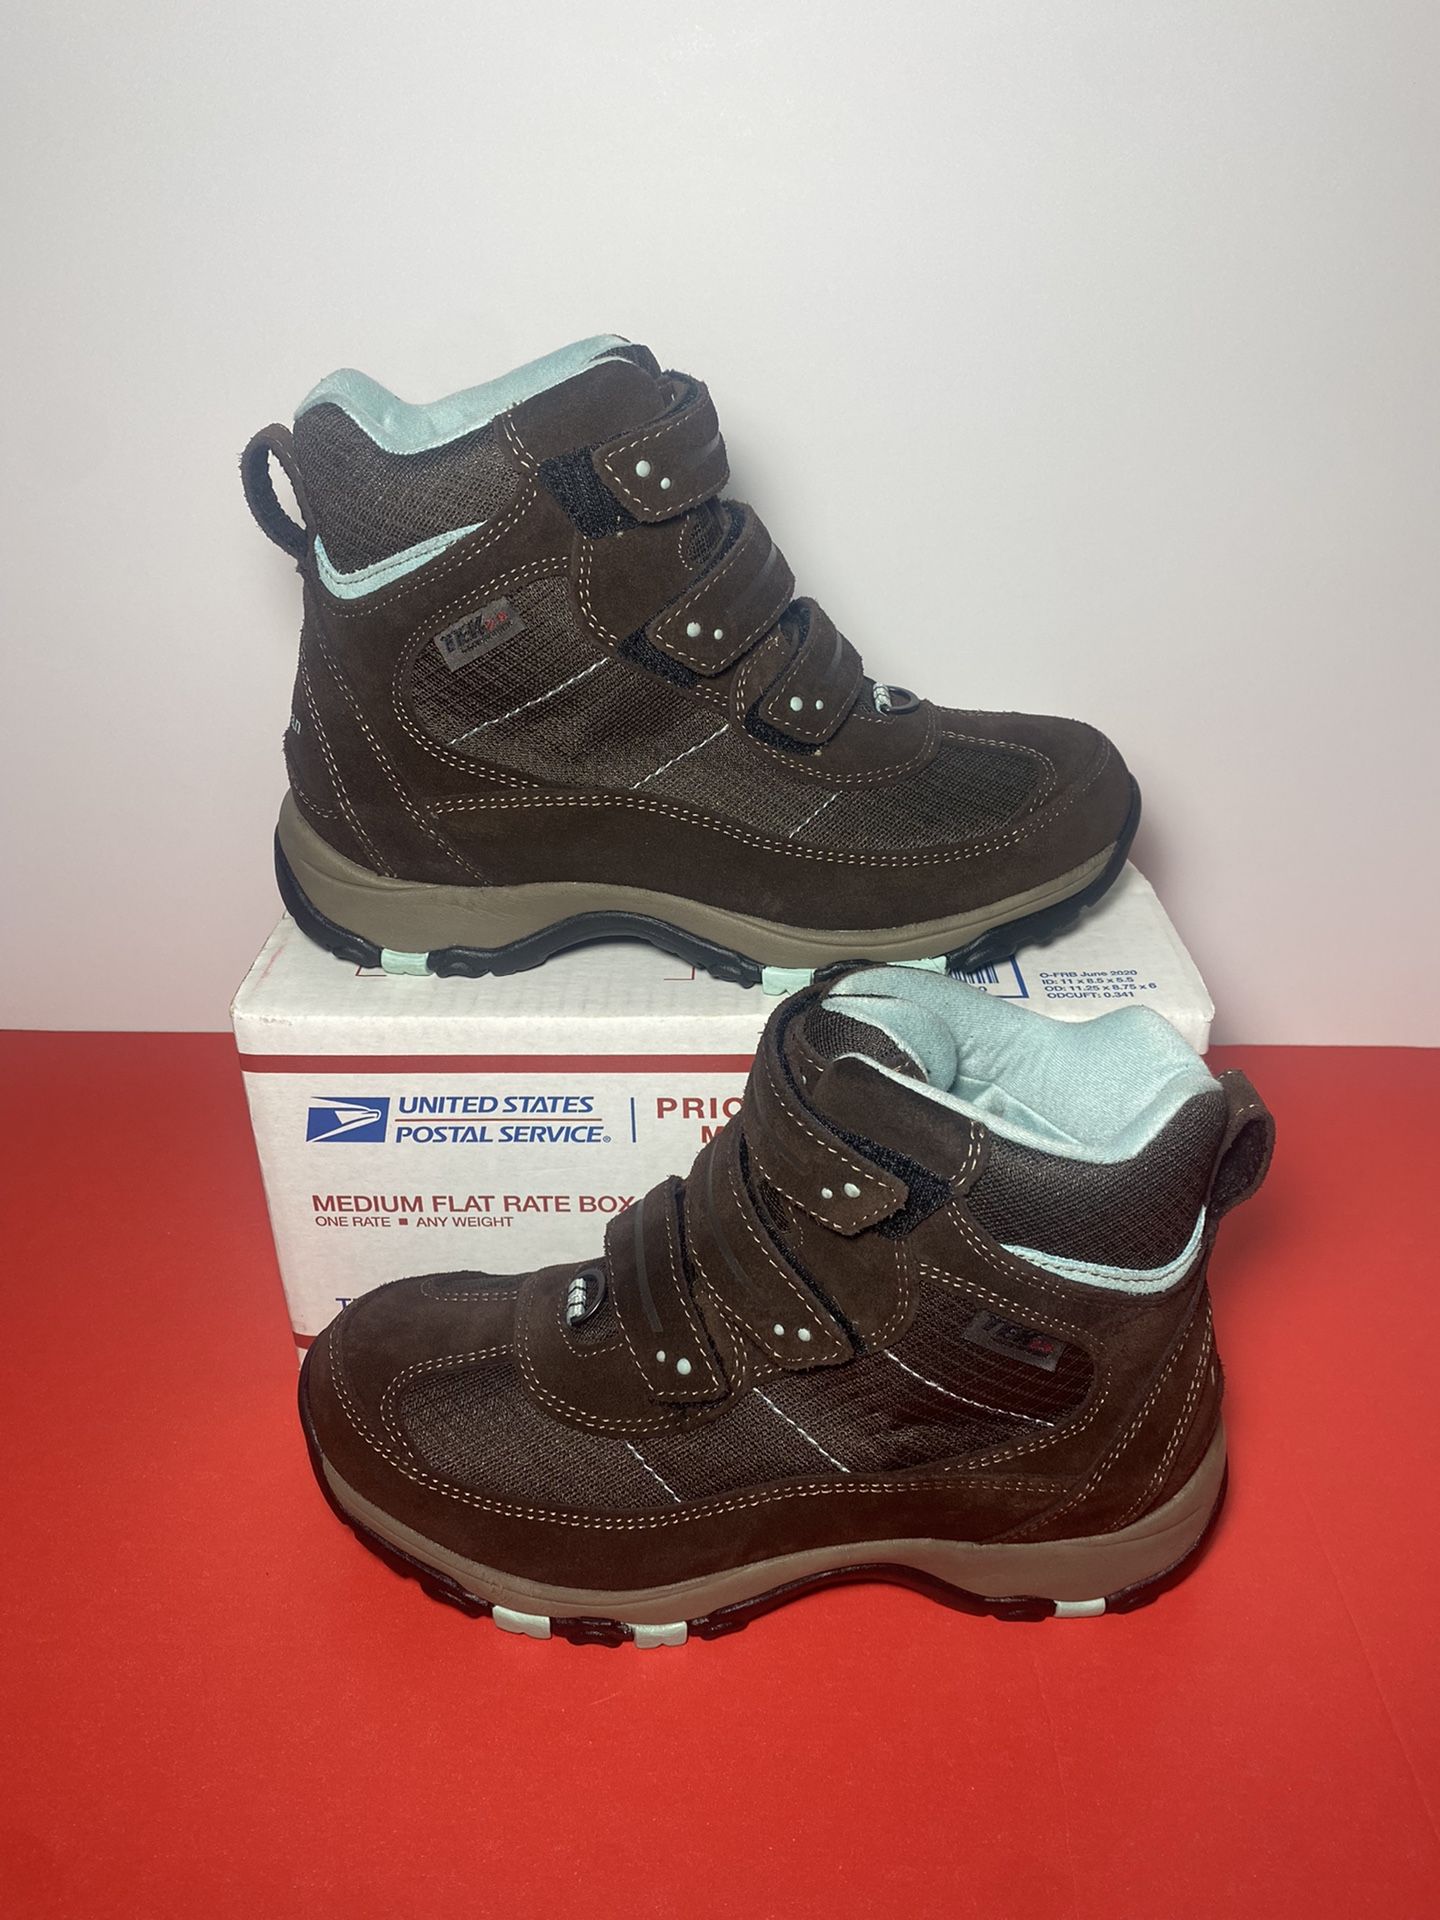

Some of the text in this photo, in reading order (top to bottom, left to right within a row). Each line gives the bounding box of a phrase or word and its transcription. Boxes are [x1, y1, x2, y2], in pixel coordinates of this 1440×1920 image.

[1039, 971, 1078, 979] O-FRB
[1080, 970, 1109, 978] June
[1046, 991, 1102, 999] ODCUFT:
[399, 1096, 595, 1114] UNITED STATES
[395, 1126, 494, 1144] POSTAL
[312, 1195, 636, 1213] MEDIUM FLAT RATE BOX
[315, 1216, 514, 1228] ONE RATE ANY WEIGHT
